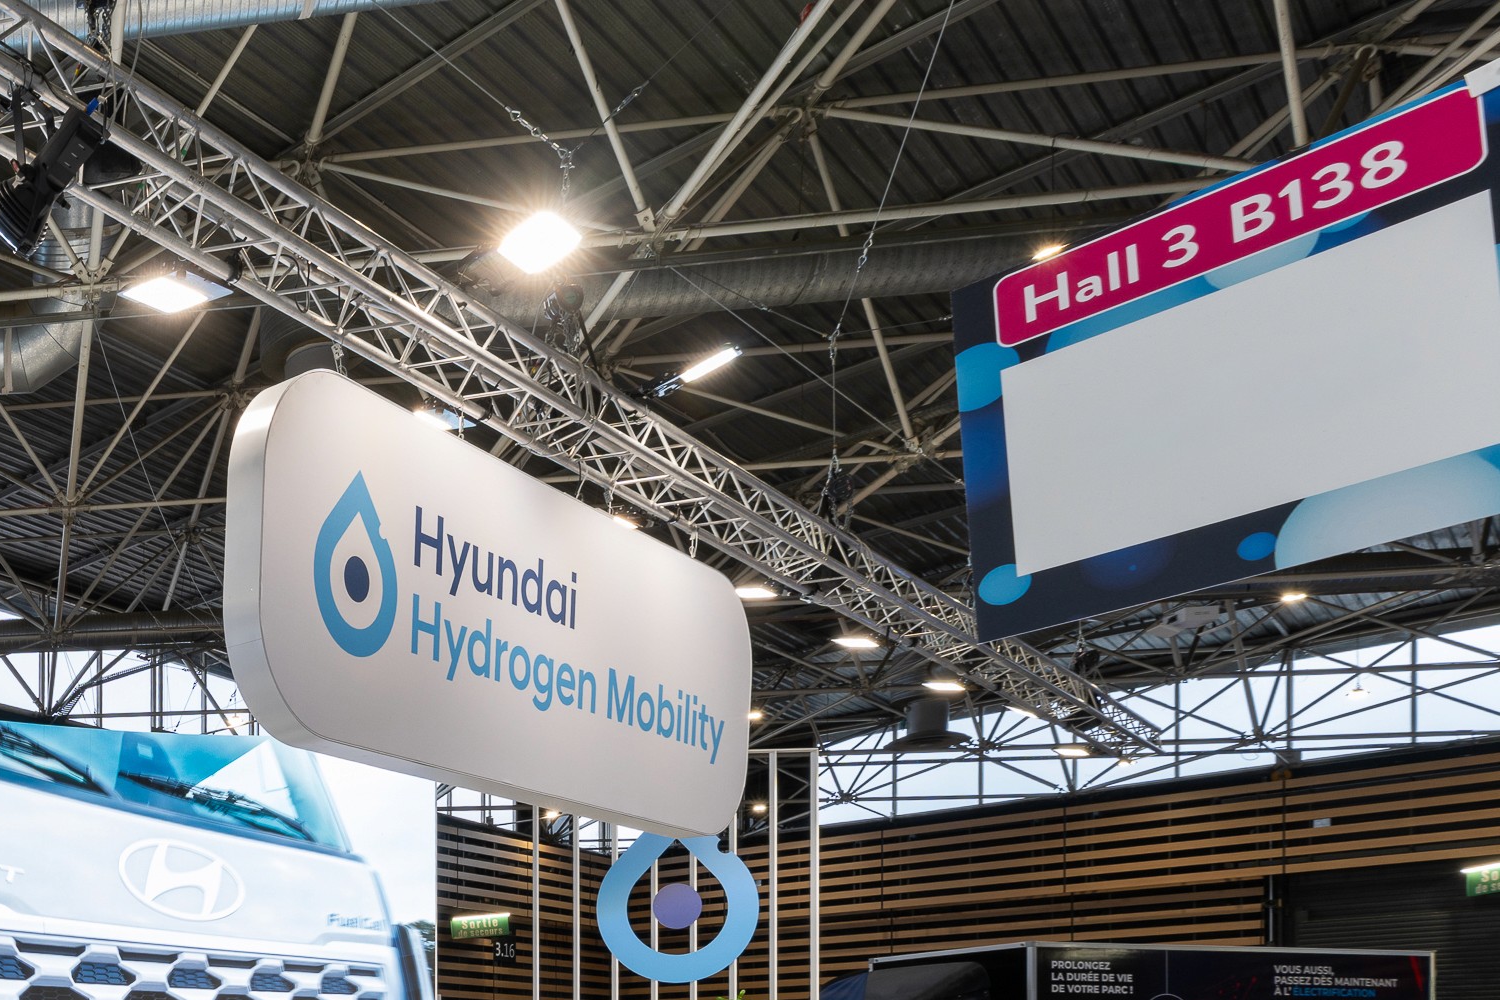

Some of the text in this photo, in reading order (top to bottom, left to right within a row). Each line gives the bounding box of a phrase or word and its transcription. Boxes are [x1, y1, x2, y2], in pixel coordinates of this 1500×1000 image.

[1023, 140, 1408, 323] Hall 3 B138
[413, 505, 577, 630] Hyundai
[411, 593, 725, 765] Hydrogen Mobility
[461, 918, 499, 930] Sortie
[458, 928, 503, 938] de secours
[495, 942, 515, 958] 3.16
[1051, 960, 1111, 970] PROLONGEZ
[1273, 965, 1335, 976] VOUS AUSSI,
[1051, 970, 1133, 982] LA DURÉE DE VIE
[1274, 975, 1398, 987] PASSEZ DÈS MAINTENANT
[1051, 984, 1065, 993] DE
[1066, 984, 1100, 994] VOTRE
[1273, 984, 1282, 996] À
